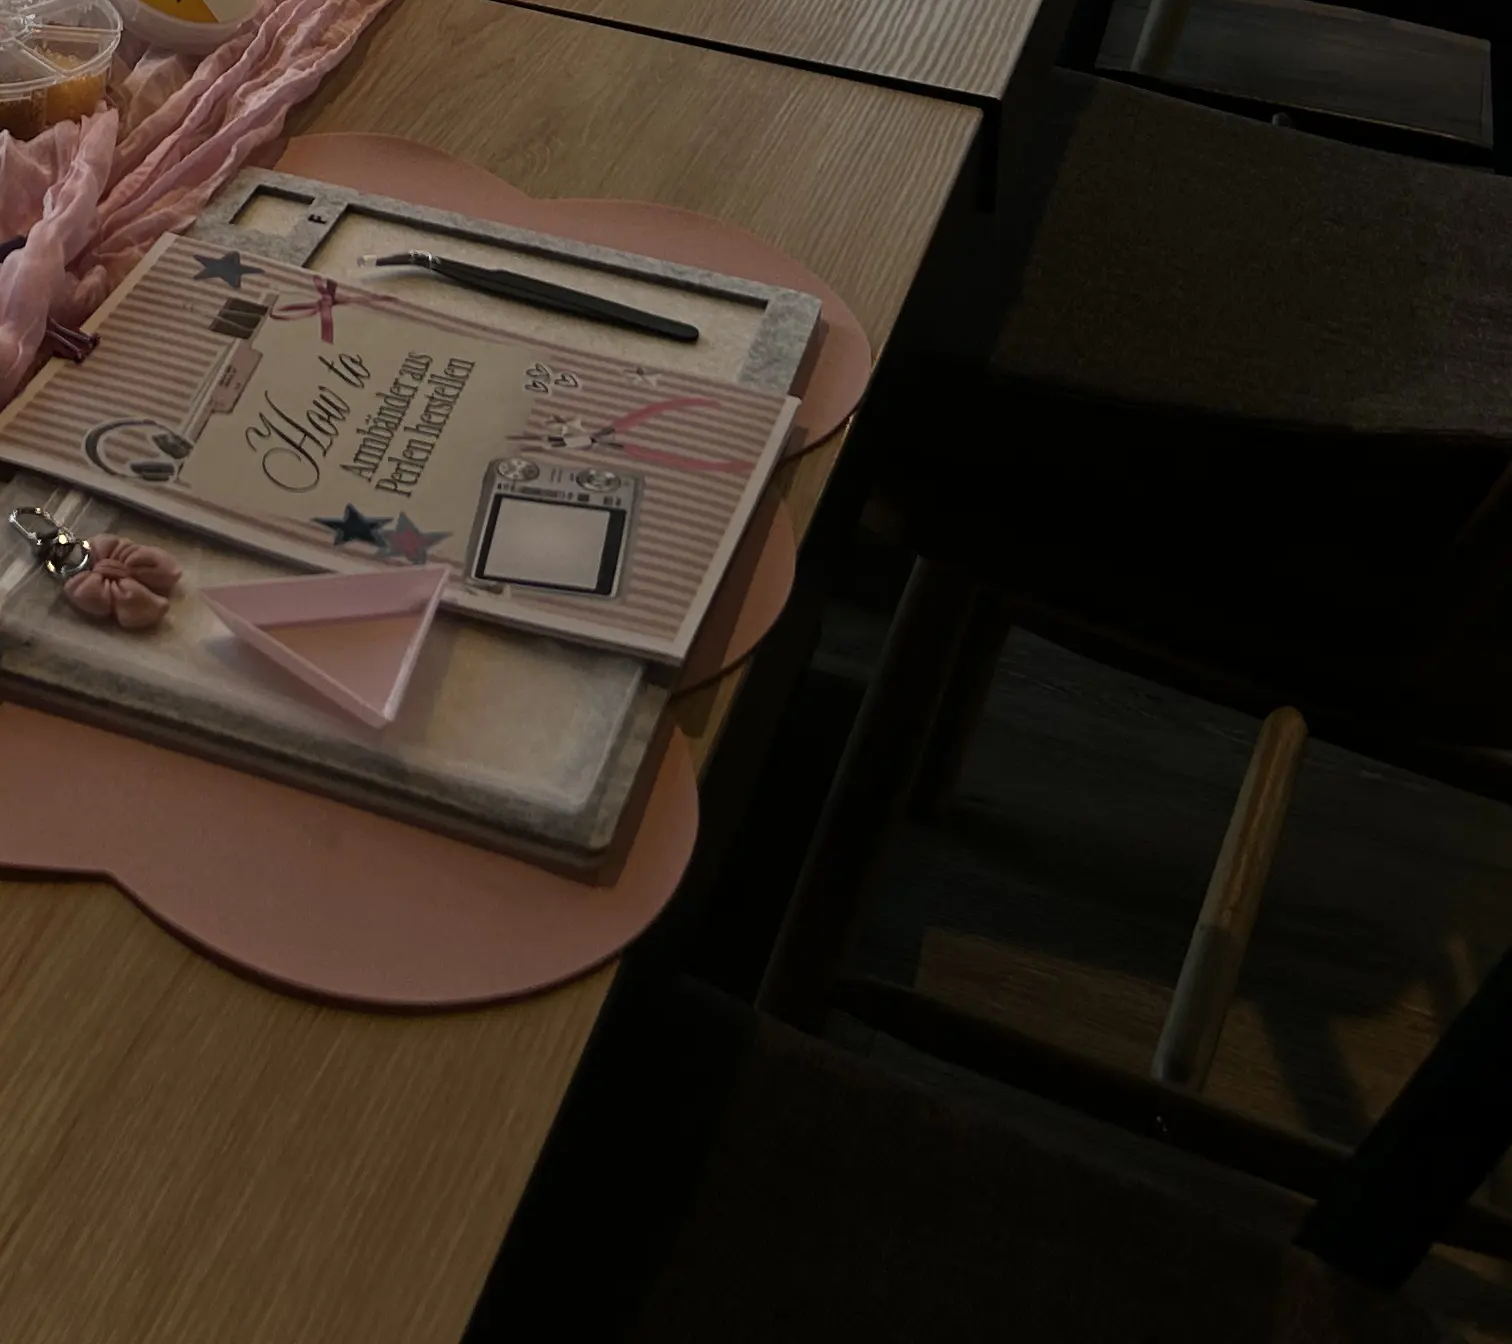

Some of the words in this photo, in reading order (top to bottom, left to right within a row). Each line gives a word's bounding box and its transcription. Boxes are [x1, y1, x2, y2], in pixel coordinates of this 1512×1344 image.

[245, 385, 351, 494] How
[318, 352, 371, 390] to
[339, 377, 419, 483] Armbänder
[398, 350, 434, 383] aus
[403, 357, 476, 439] herstellen
[374, 438, 436, 498] Perlen
